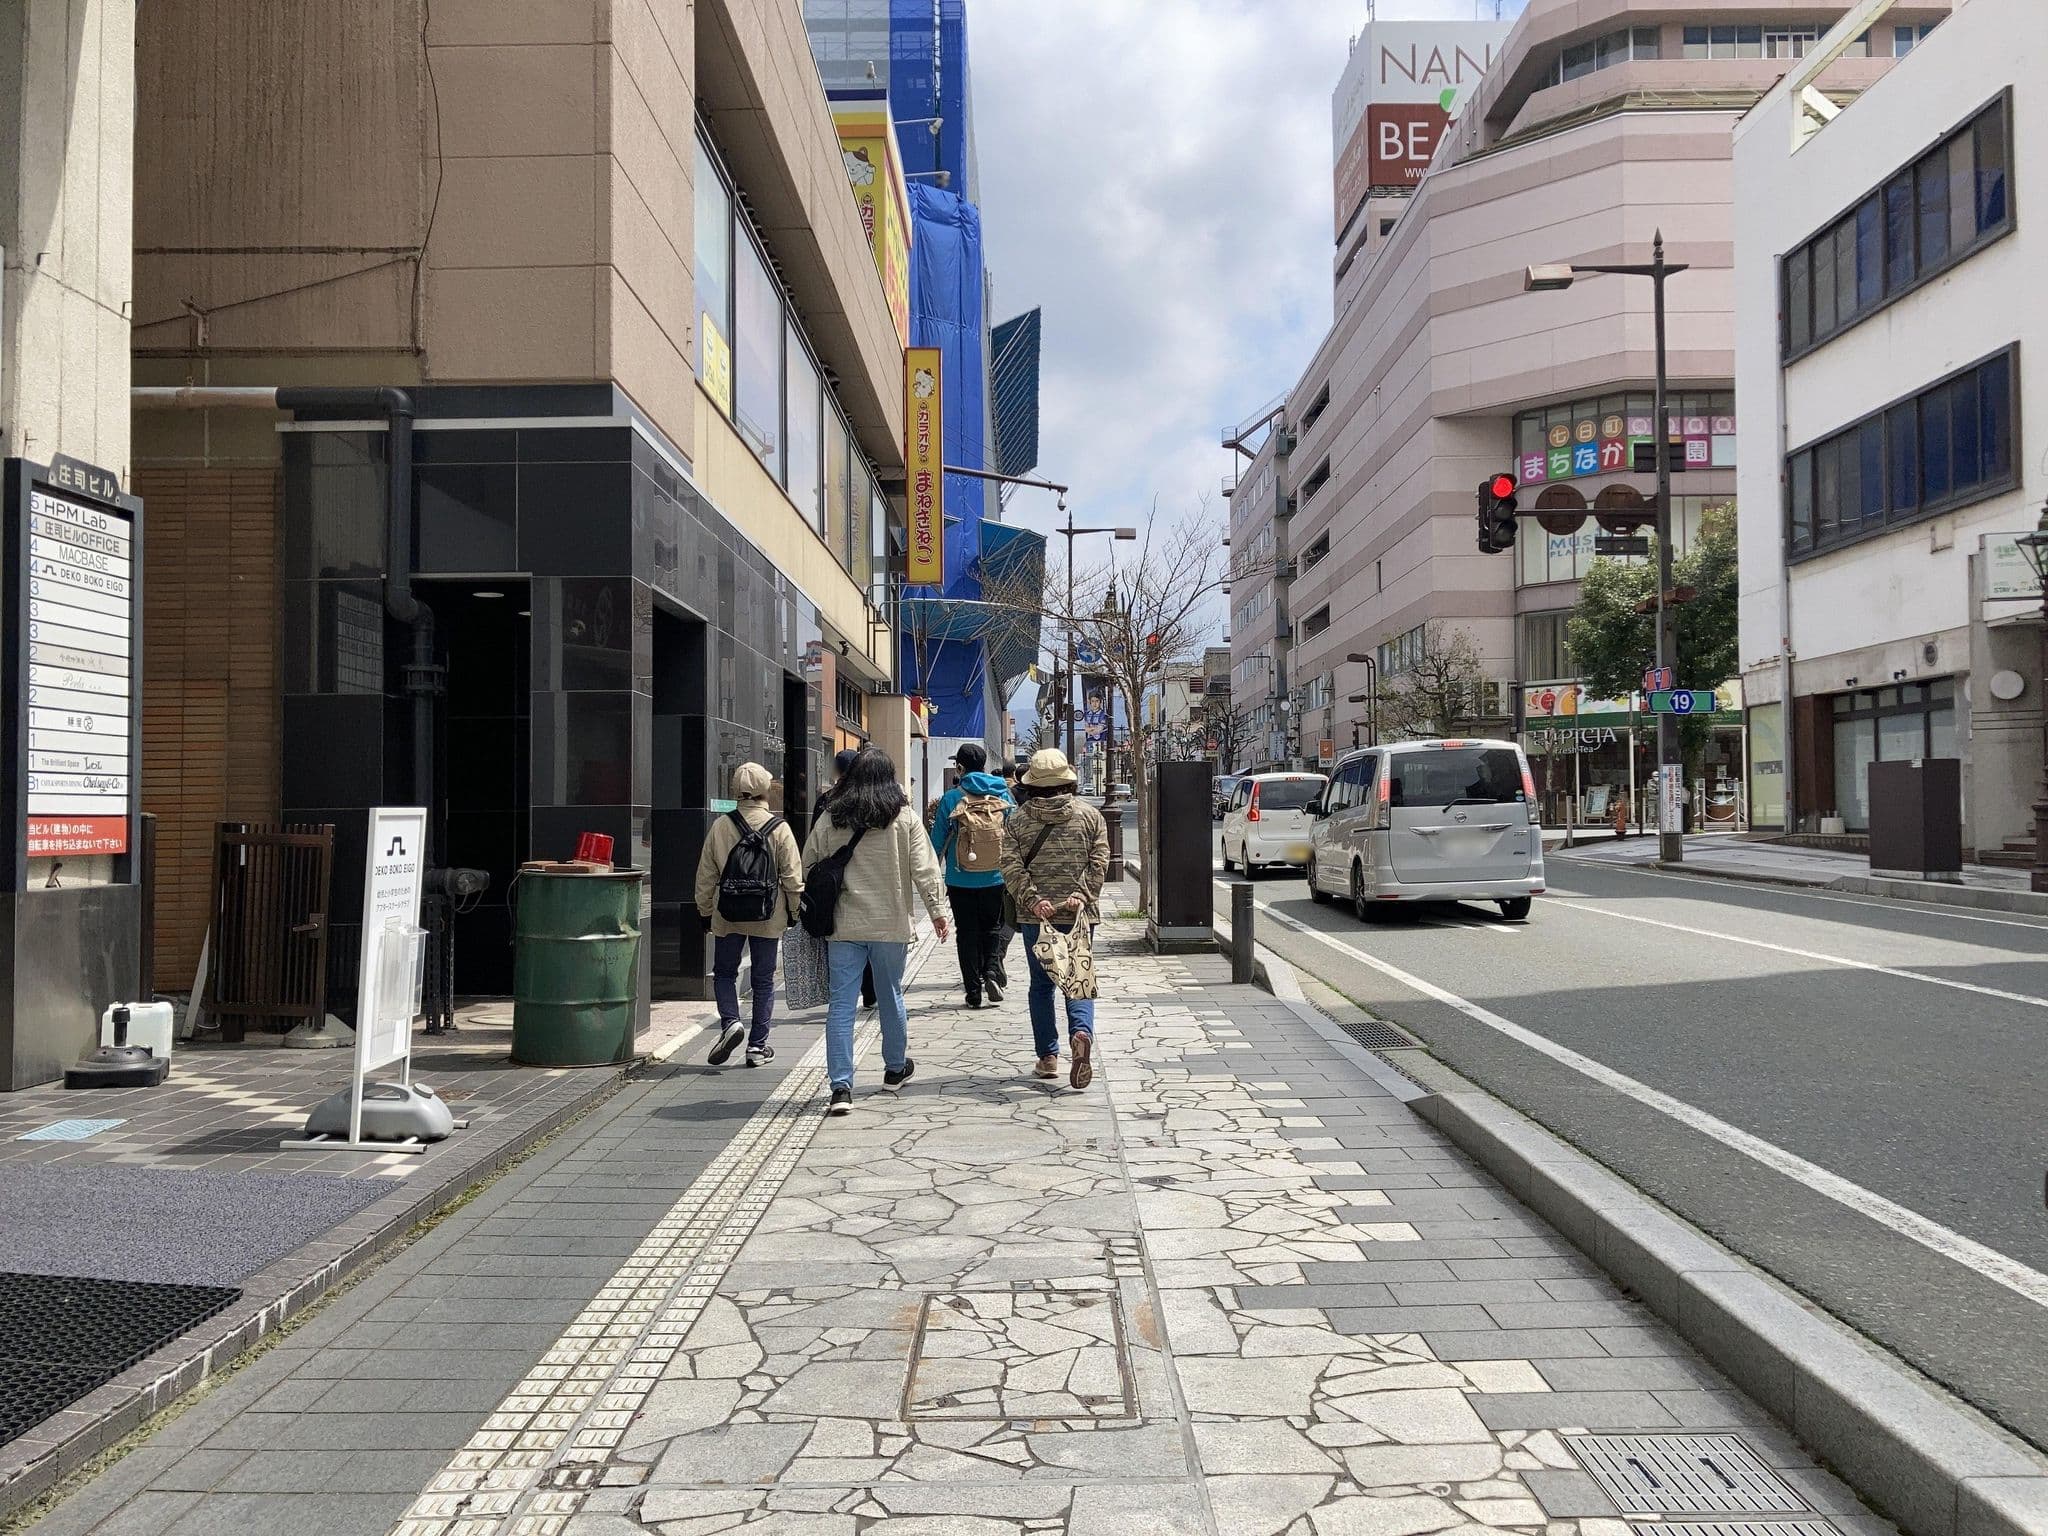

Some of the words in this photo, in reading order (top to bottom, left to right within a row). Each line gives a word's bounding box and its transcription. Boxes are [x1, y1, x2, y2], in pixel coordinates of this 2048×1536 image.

[917, 411, 930, 455] カラオケ
[59, 464, 114, 498] 庄司ビル
[31, 495, 39, 510] 5
[44, 499, 78, 522] HPM
[82, 515, 107, 530] Lab
[915, 468, 934, 565] まねきねこ
[45, 521, 120, 554] 庄司ビルOFFICE
[31, 539, 38, 553] 4
[58, 545, 109, 572] MACBASE
[31, 559, 38, 574] 4
[61, 568, 81, 582] DEKO
[84, 574, 104, 588] BOKO
[106, 579, 123, 593] EIGO
[30, 580, 39, 595] 3
[30, 603, 38, 617] 3
[30, 623, 38, 639] 3
[30, 646, 37, 660] 2
[30, 667, 37, 682] 2
[30, 688, 37, 703] 2
[1673, 694, 1688, 709] 19
[1579, 745, 1594, 753] Tea
[28, 775, 39, 791] B1
[28, 838, 122, 851] 自転車を持ち込まないで下さい
